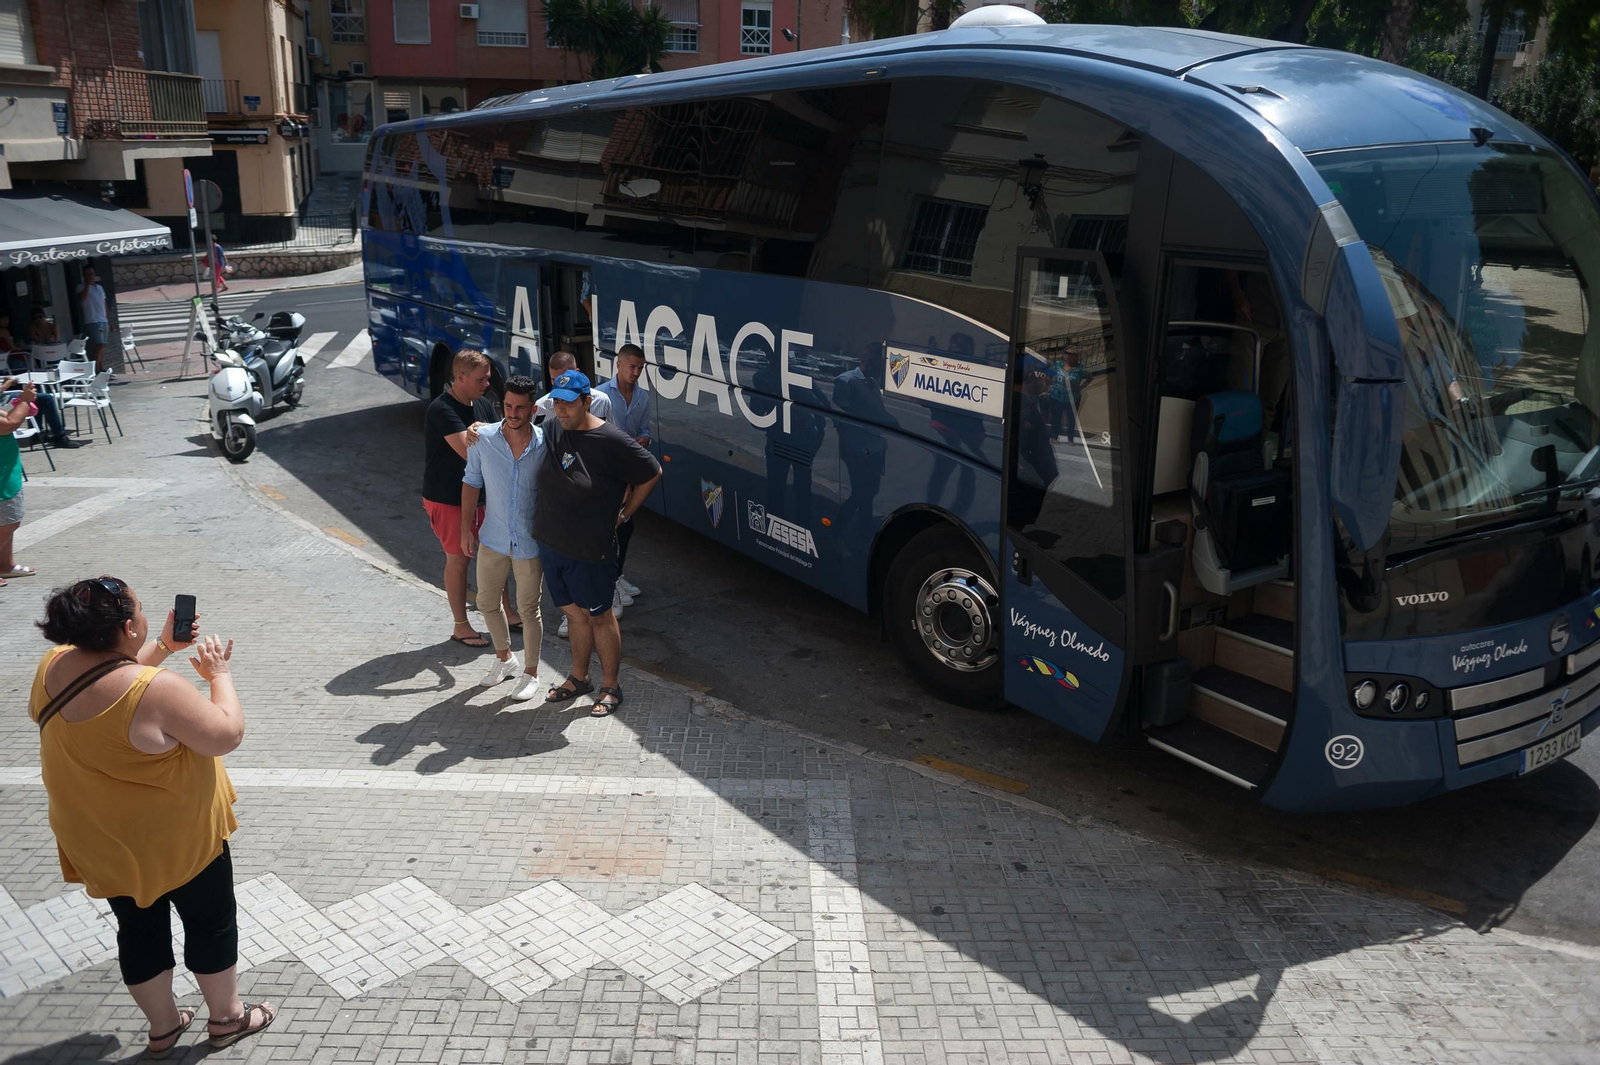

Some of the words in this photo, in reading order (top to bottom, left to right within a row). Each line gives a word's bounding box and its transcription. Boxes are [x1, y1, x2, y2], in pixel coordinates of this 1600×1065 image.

[9, 246, 90, 265] Pastora
[96, 235, 170, 254] Cafetería
[914, 372, 989, 403] MALAGACF
[766, 512, 819, 559] TESESA
[1395, 590, 1450, 606] VOLVO
[1010, 607, 1058, 648] Vázquez
[1060, 629, 1110, 662] Olmedo
[1460, 638, 1495, 653] autocares
[1452, 652, 1492, 673] Vázquez
[1494, 638, 1528, 662] Olmedo
[1331, 743, 1359, 761] 92
[1529, 740, 1558, 768] 1233
